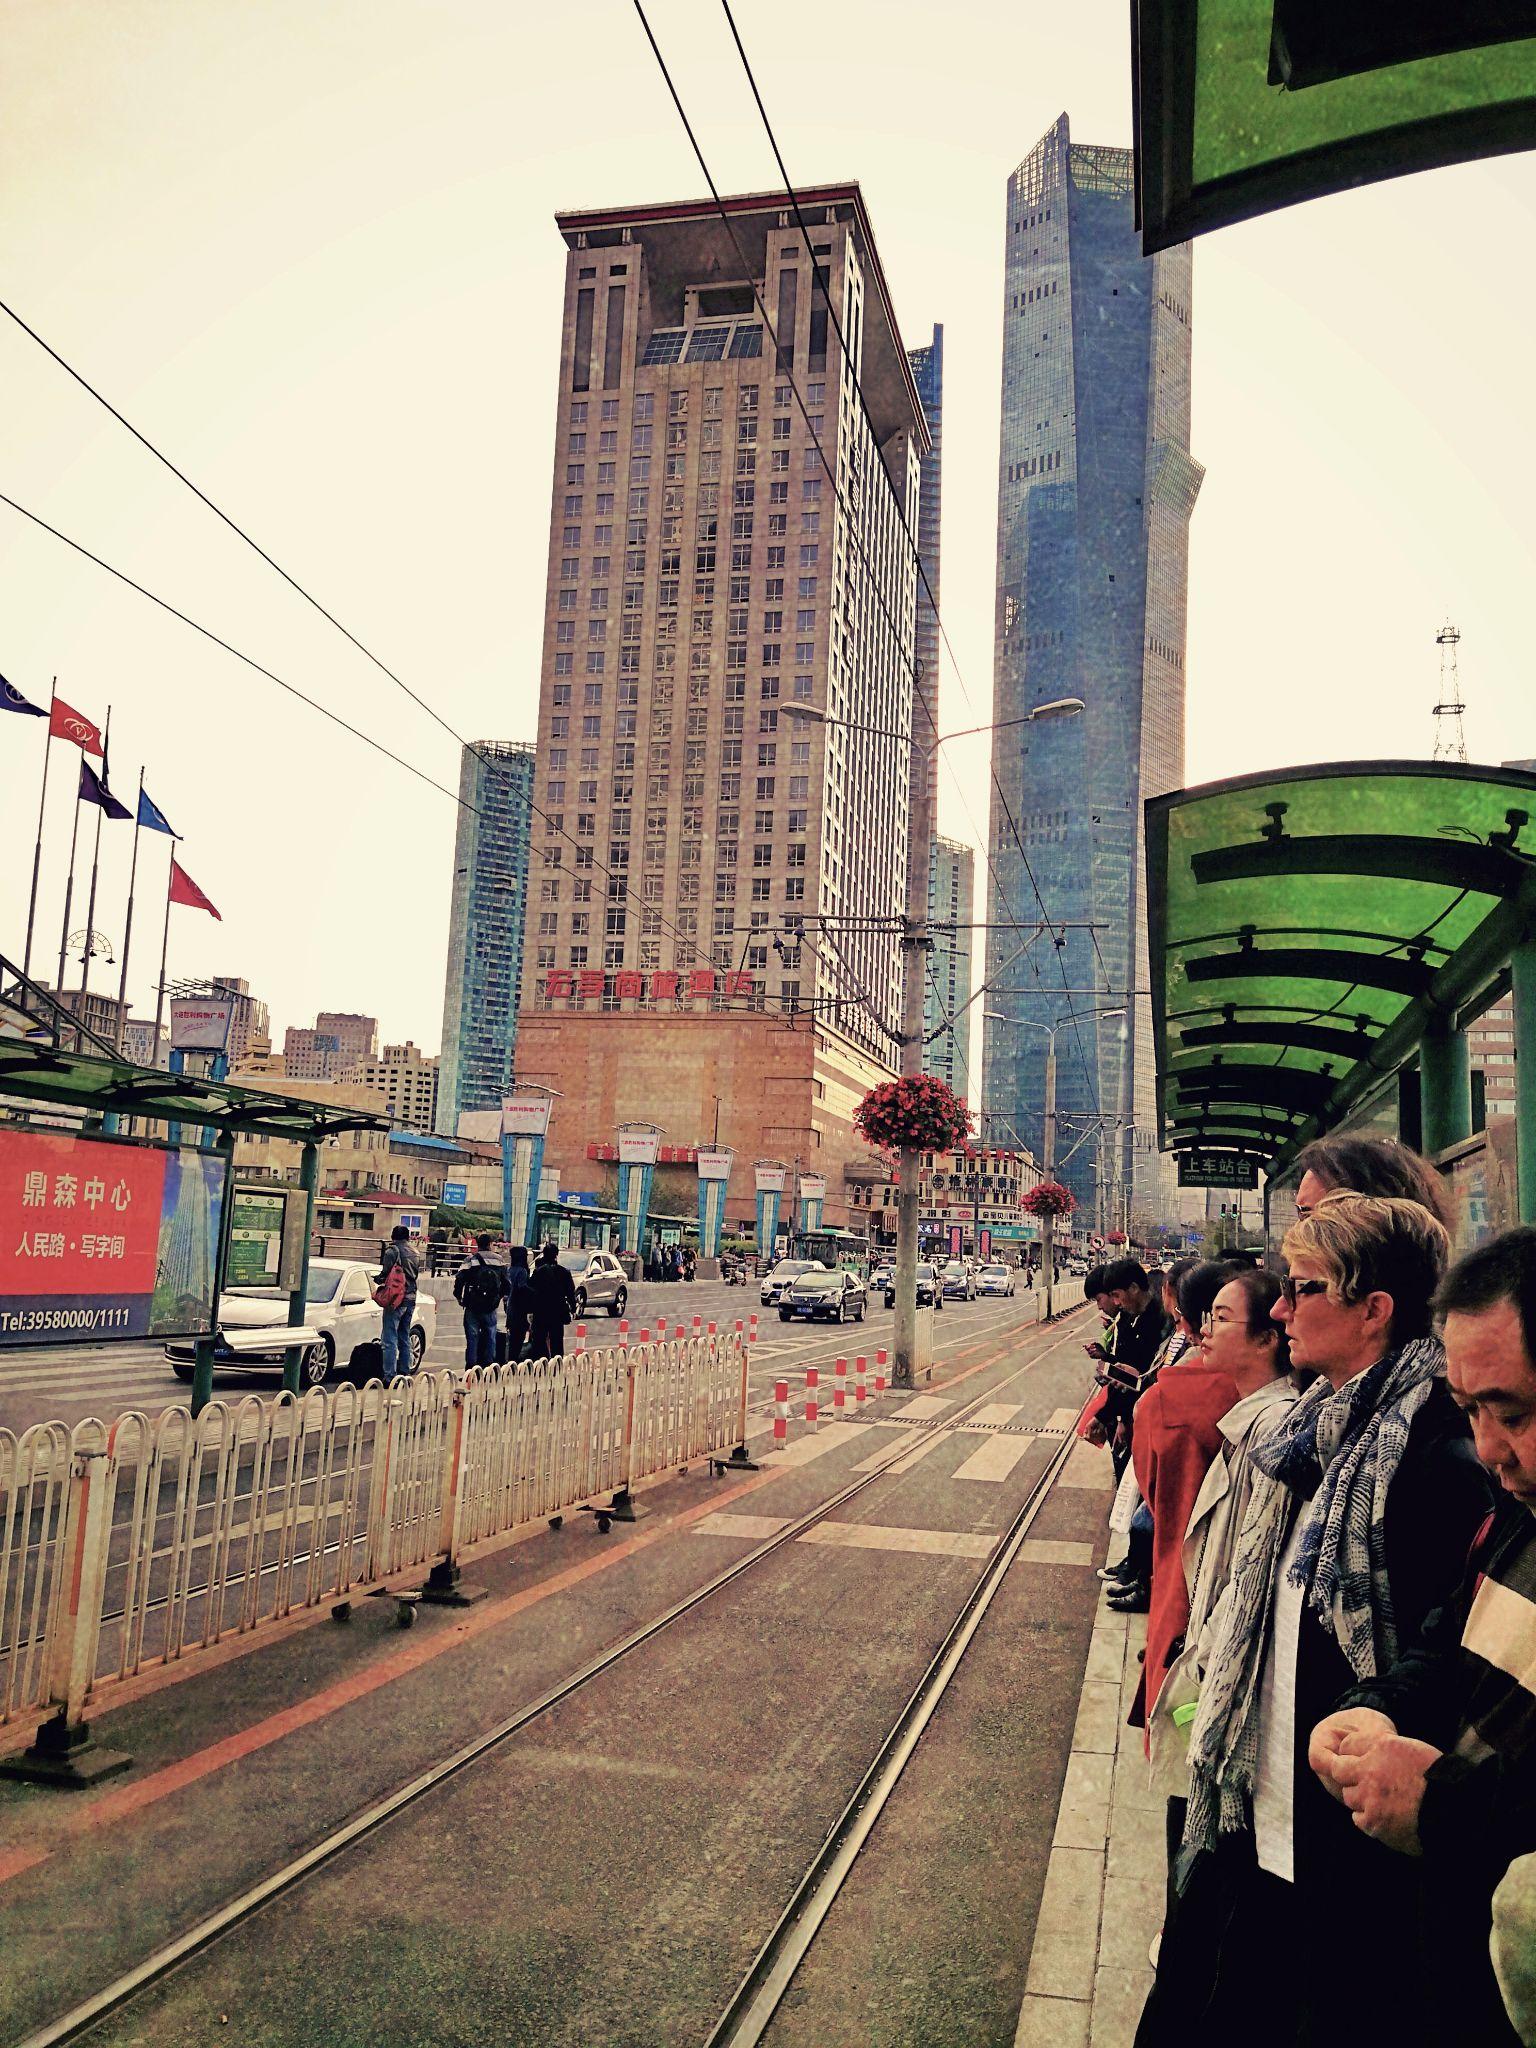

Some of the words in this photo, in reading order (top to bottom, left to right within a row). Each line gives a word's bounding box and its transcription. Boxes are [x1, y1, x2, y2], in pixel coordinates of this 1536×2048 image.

[1184, 1157, 1251, 1175] 上车站台
[22, 1171, 132, 1211] 鼎森中心
[15, 1232, 126, 1259] 人民路·写字间
[1, 1308, 129, 1331] Tel:39580000/1111
